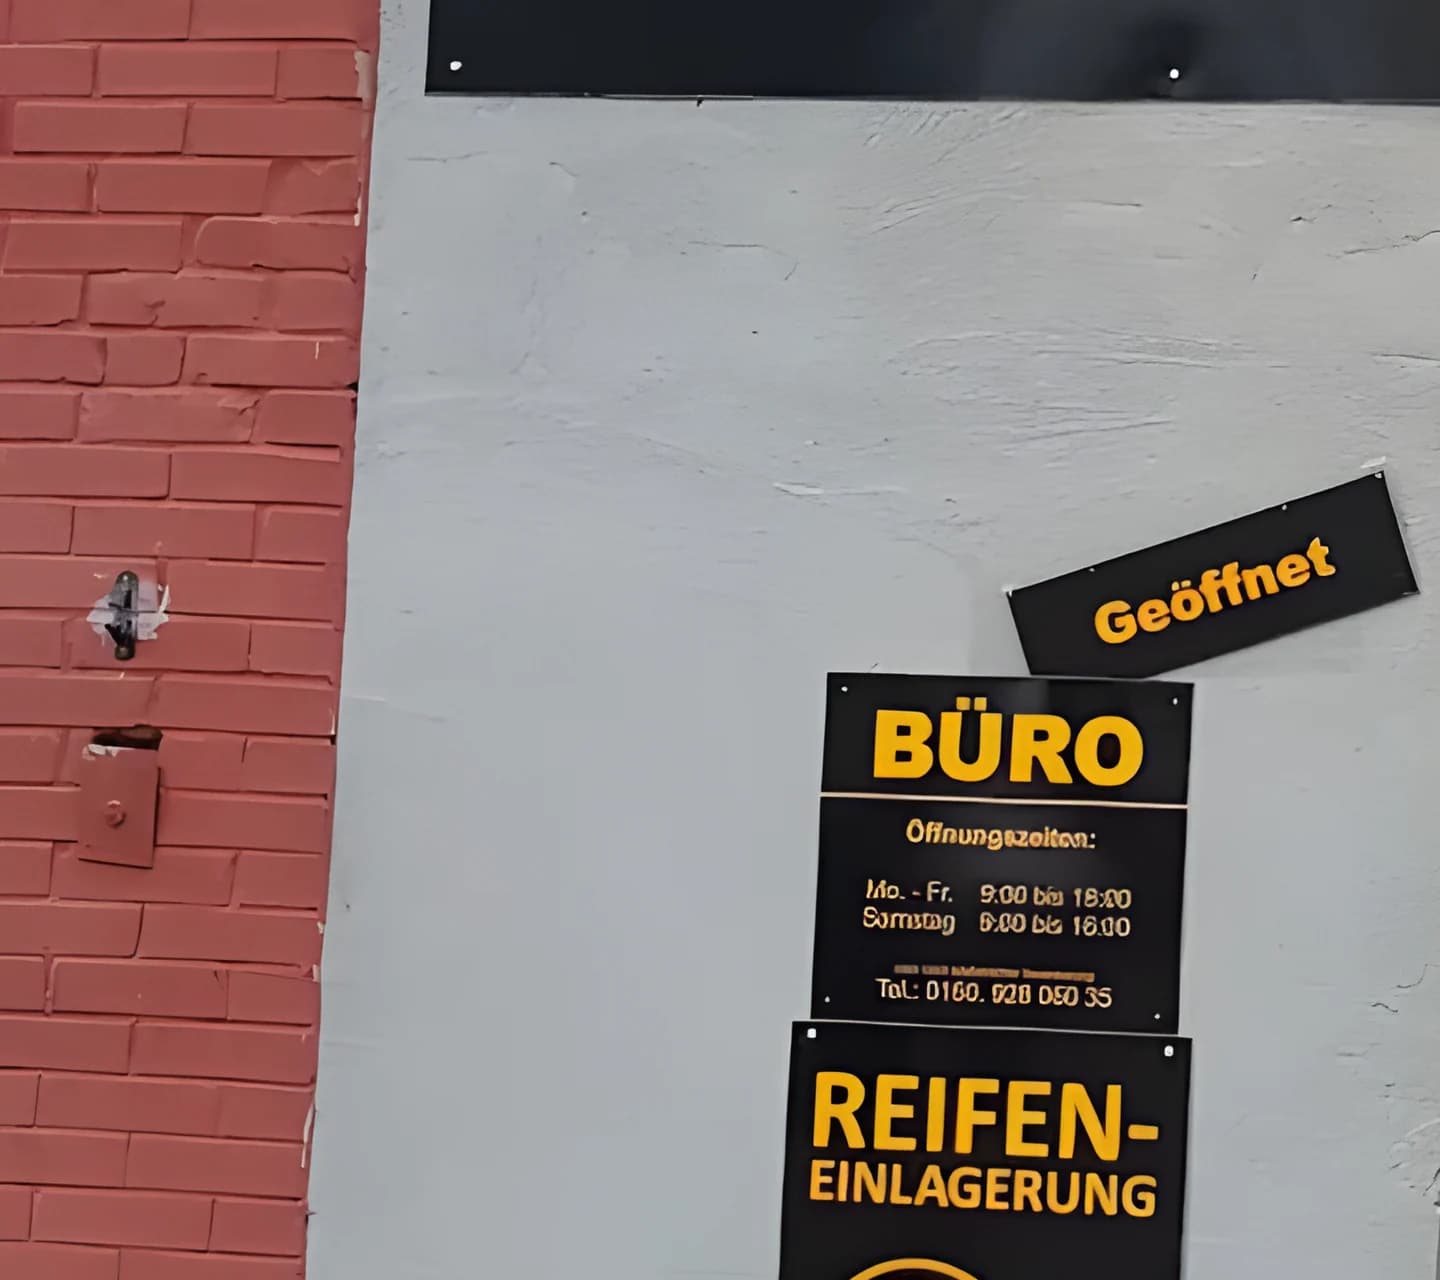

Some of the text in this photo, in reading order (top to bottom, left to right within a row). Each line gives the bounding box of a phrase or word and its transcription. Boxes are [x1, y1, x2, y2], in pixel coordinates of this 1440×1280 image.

[1095, 538, 1335, 643] Geöffnet
[874, 697, 1143, 786] BÜRO
[863, 906, 955, 936] Samstag
[1032, 915, 1062, 934] bis
[926, 881, 954, 903] Fr.
[1034, 886, 1063, 906] bis
[812, 1071, 1159, 1161] REIFEN-
[810, 1160, 1156, 1217] EINLAGERUNG
